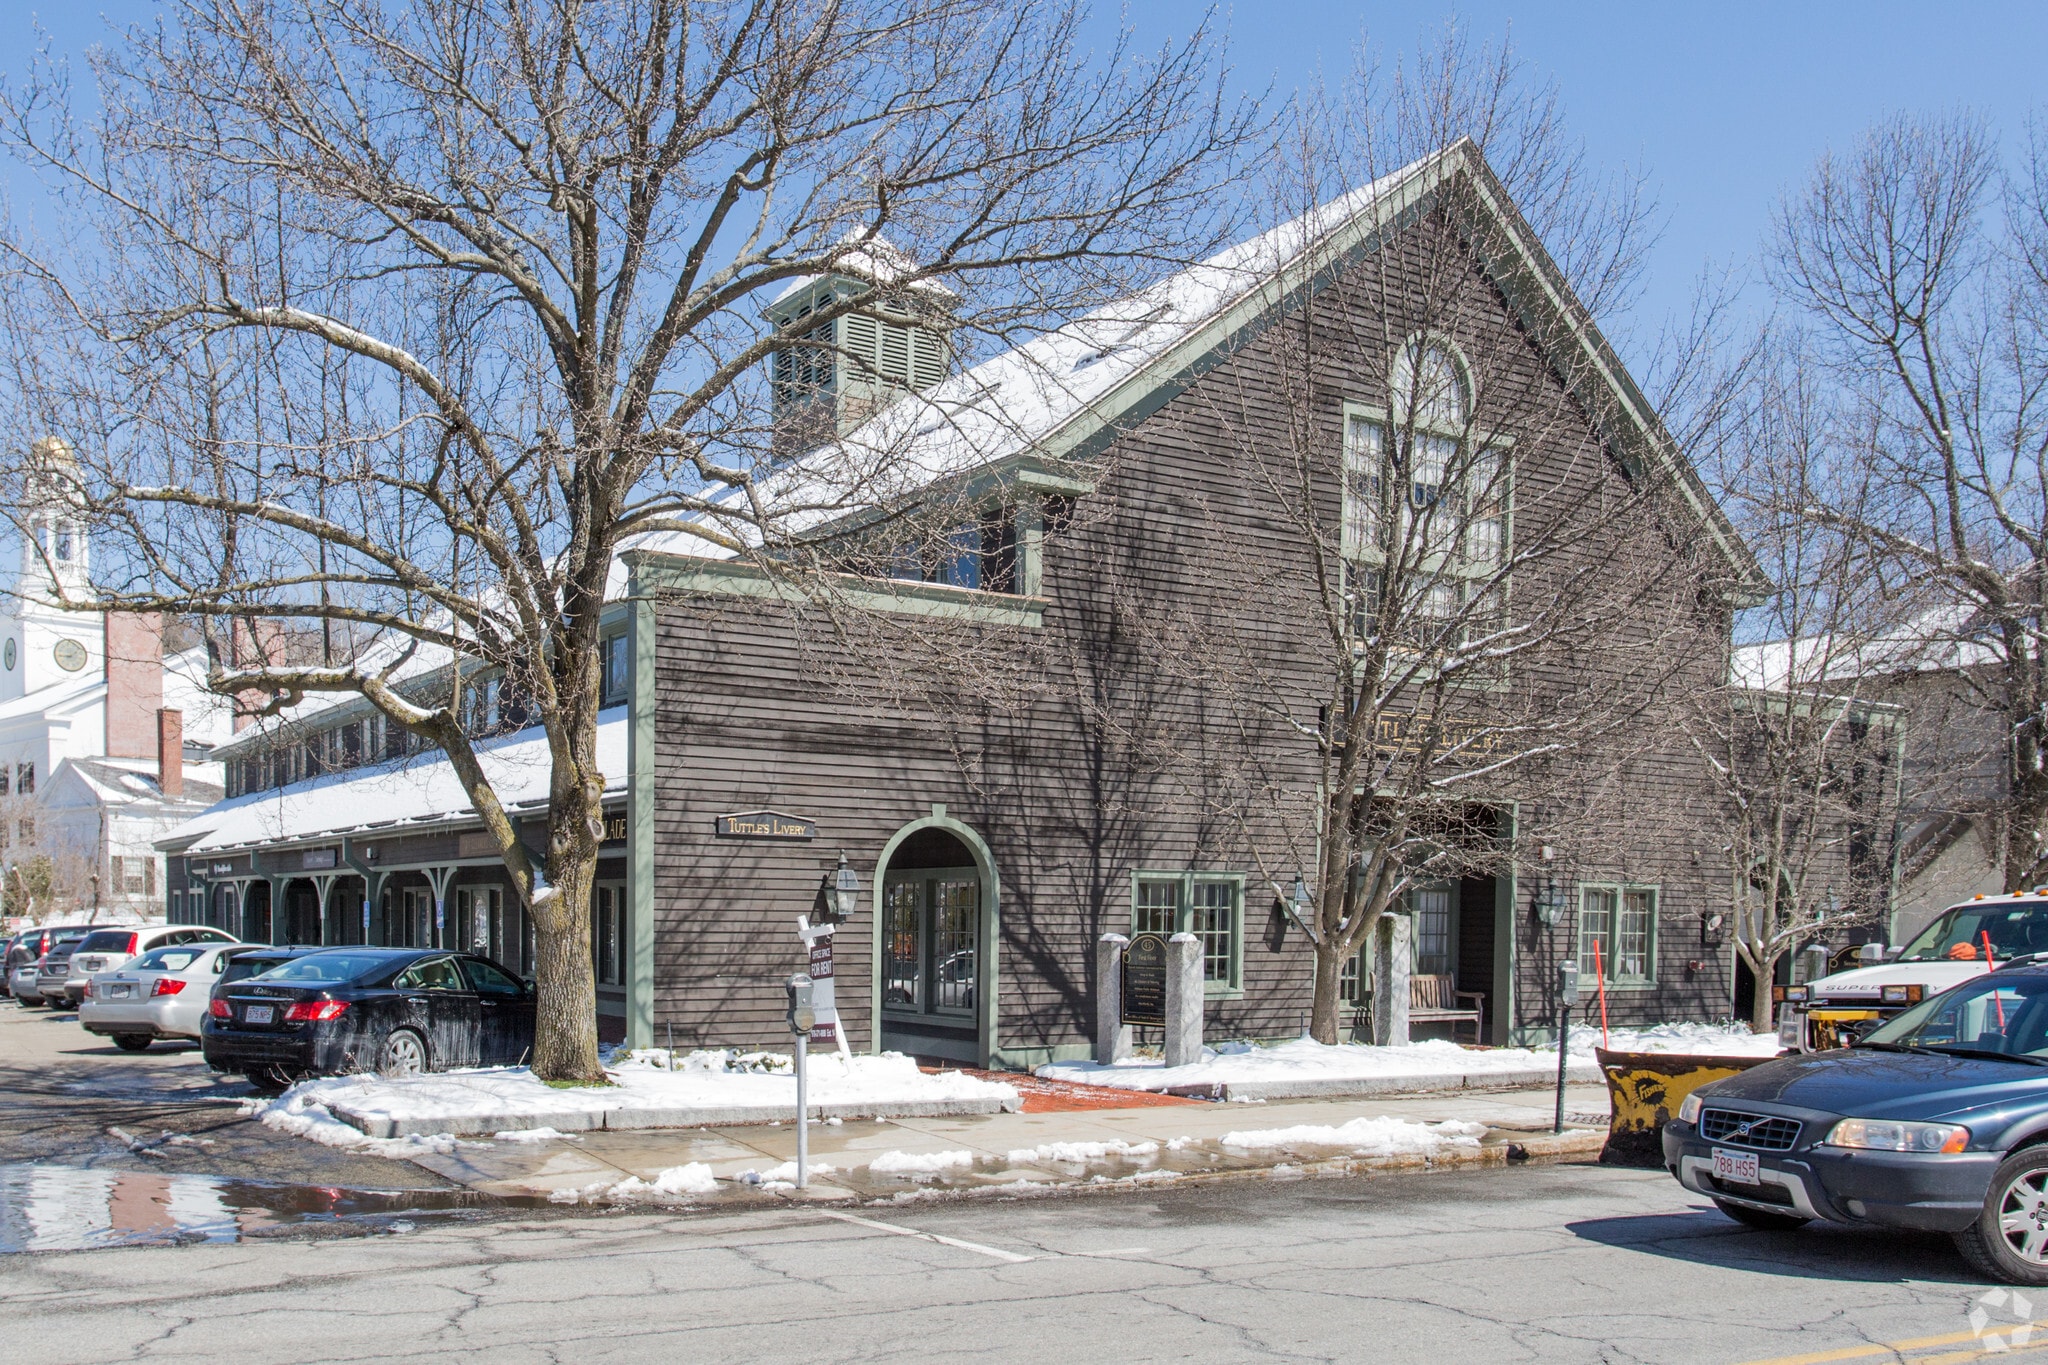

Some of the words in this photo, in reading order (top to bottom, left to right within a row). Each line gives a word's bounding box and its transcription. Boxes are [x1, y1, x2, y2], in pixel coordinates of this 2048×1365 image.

[728, 817, 770, 834] TUTTLE'S
[773, 819, 807, 835] LIVERY
[811, 962, 820, 977] FOR
[820, 960, 833, 975] RENT
[1713, 1155, 1733, 1174] 788
[1735, 1159, 1756, 1178] HS5
